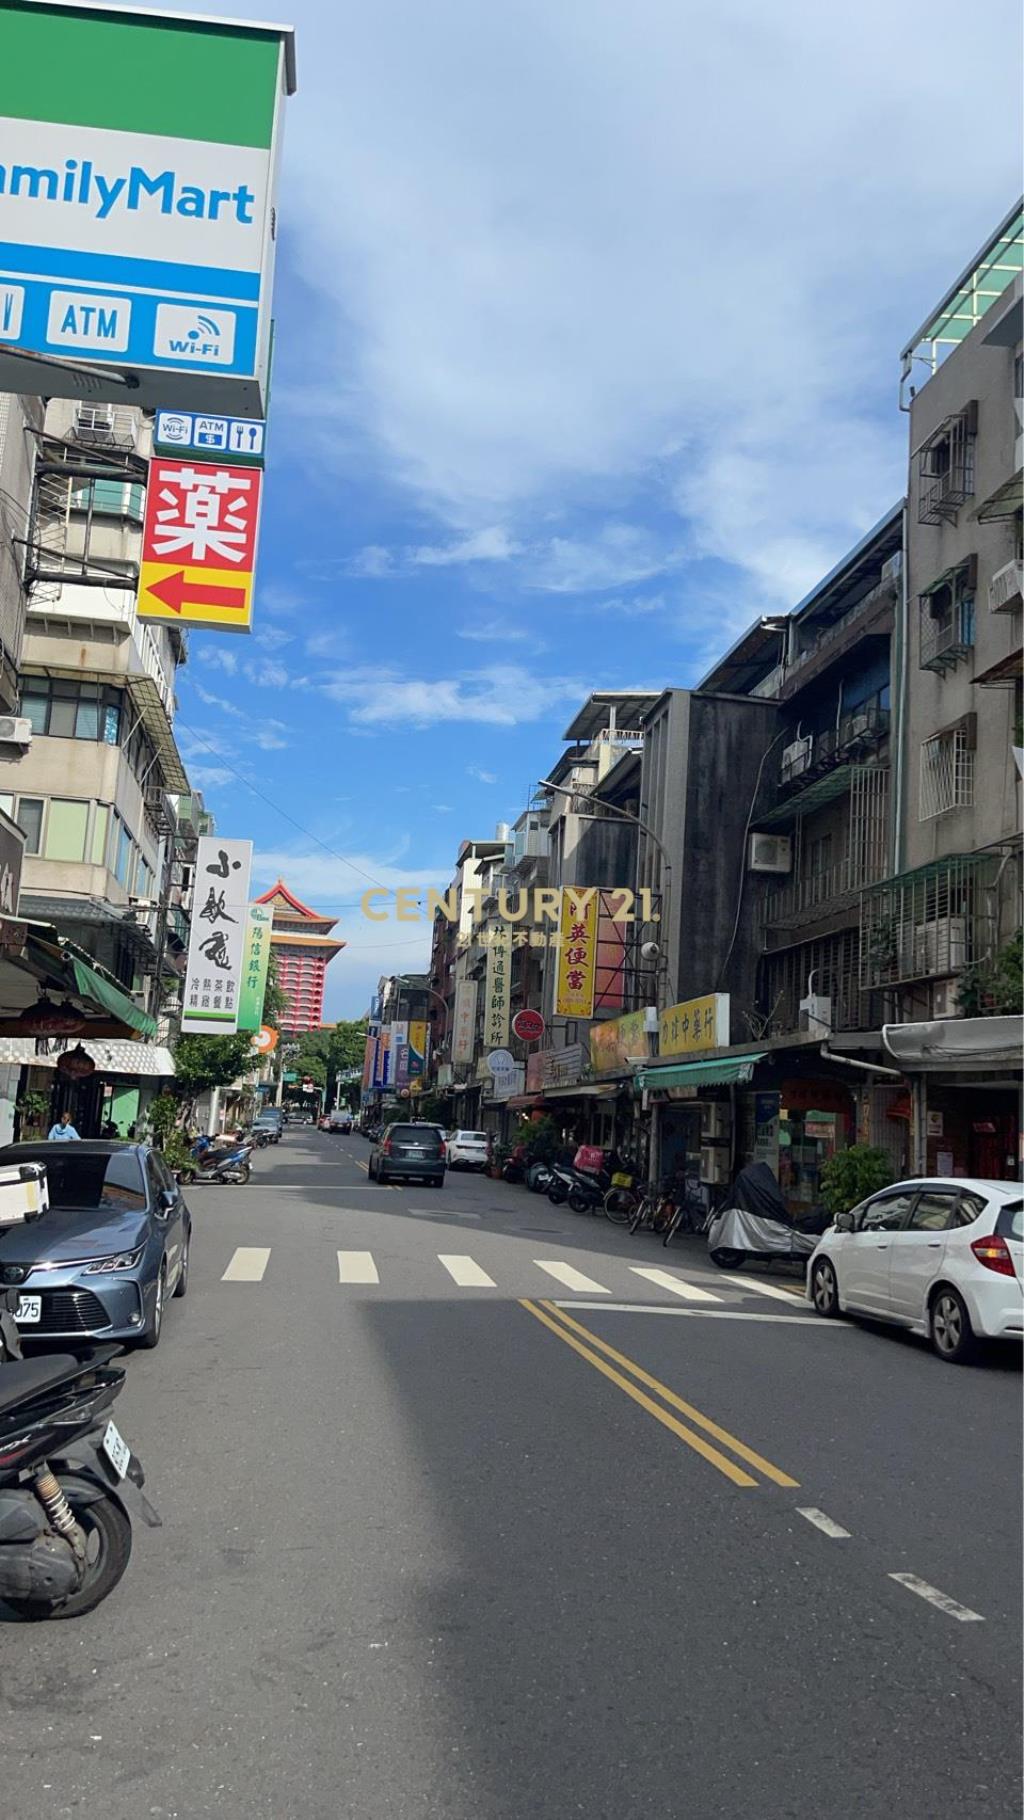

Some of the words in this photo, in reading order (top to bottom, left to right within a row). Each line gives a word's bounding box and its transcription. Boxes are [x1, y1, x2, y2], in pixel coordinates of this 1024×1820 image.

[0, 159, 255, 224] milyMart
[61, 304, 118, 339] ATM
[169, 340, 219, 357] Wi-Fi
[162, 422, 188, 435] Wi-Fi
[200, 419, 225, 432] ATM
[247, 926, 264, 989] 陽信銀行
